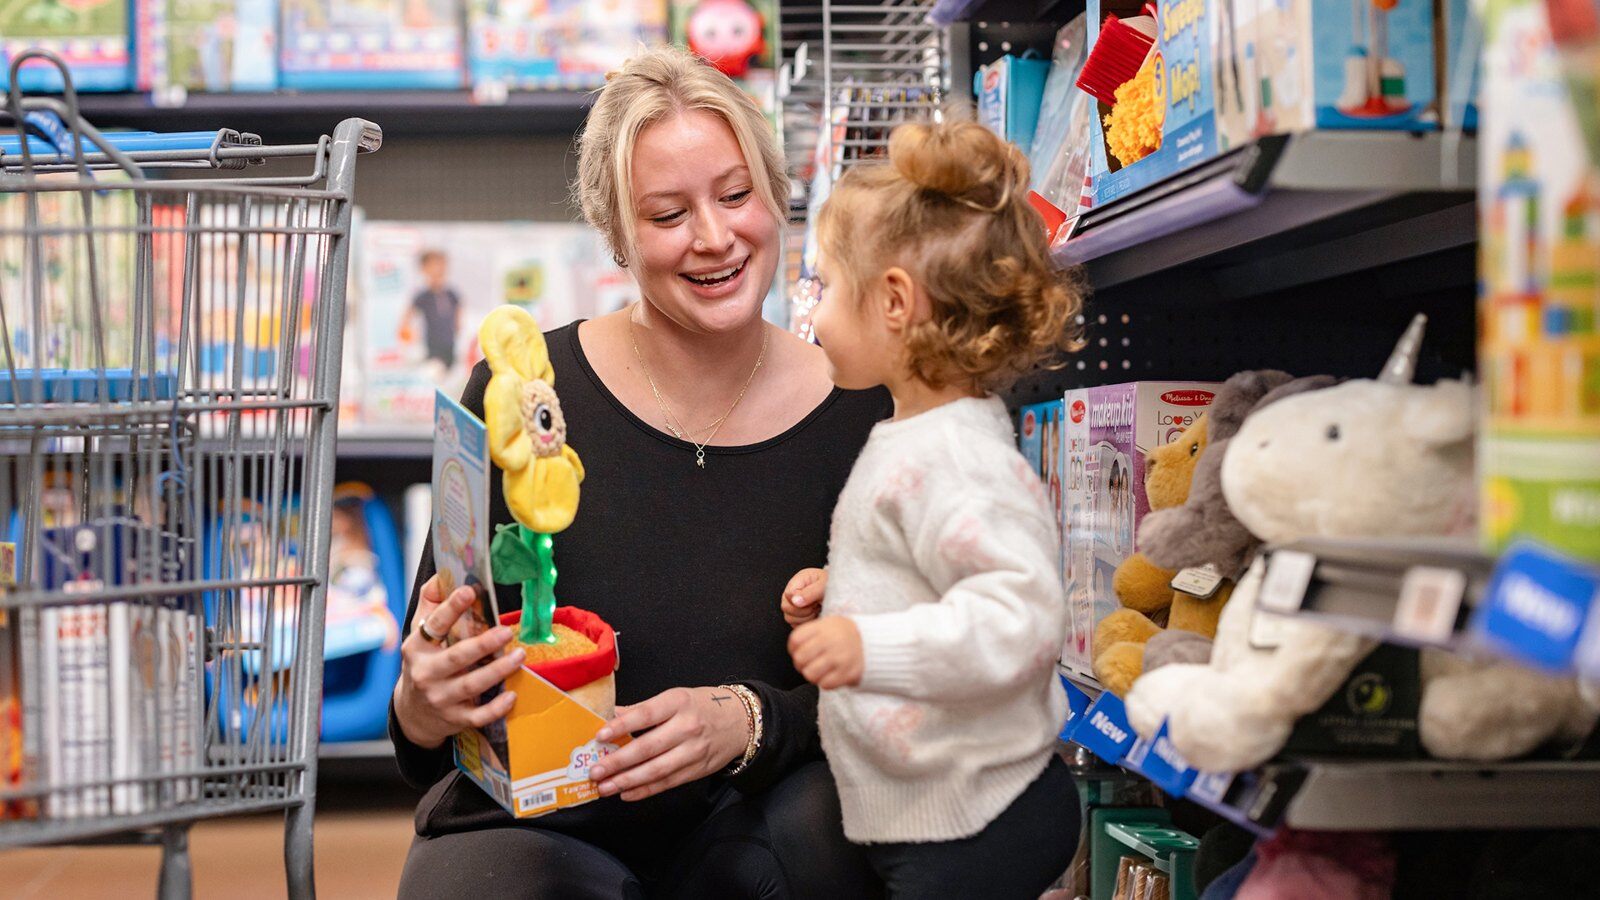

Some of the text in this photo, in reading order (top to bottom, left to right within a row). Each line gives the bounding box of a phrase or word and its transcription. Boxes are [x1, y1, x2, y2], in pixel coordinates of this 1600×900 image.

[1170, 46, 1200, 110] Mop!
[1091, 393, 1133, 432] makeup kit
[1090, 710, 1128, 745] New
